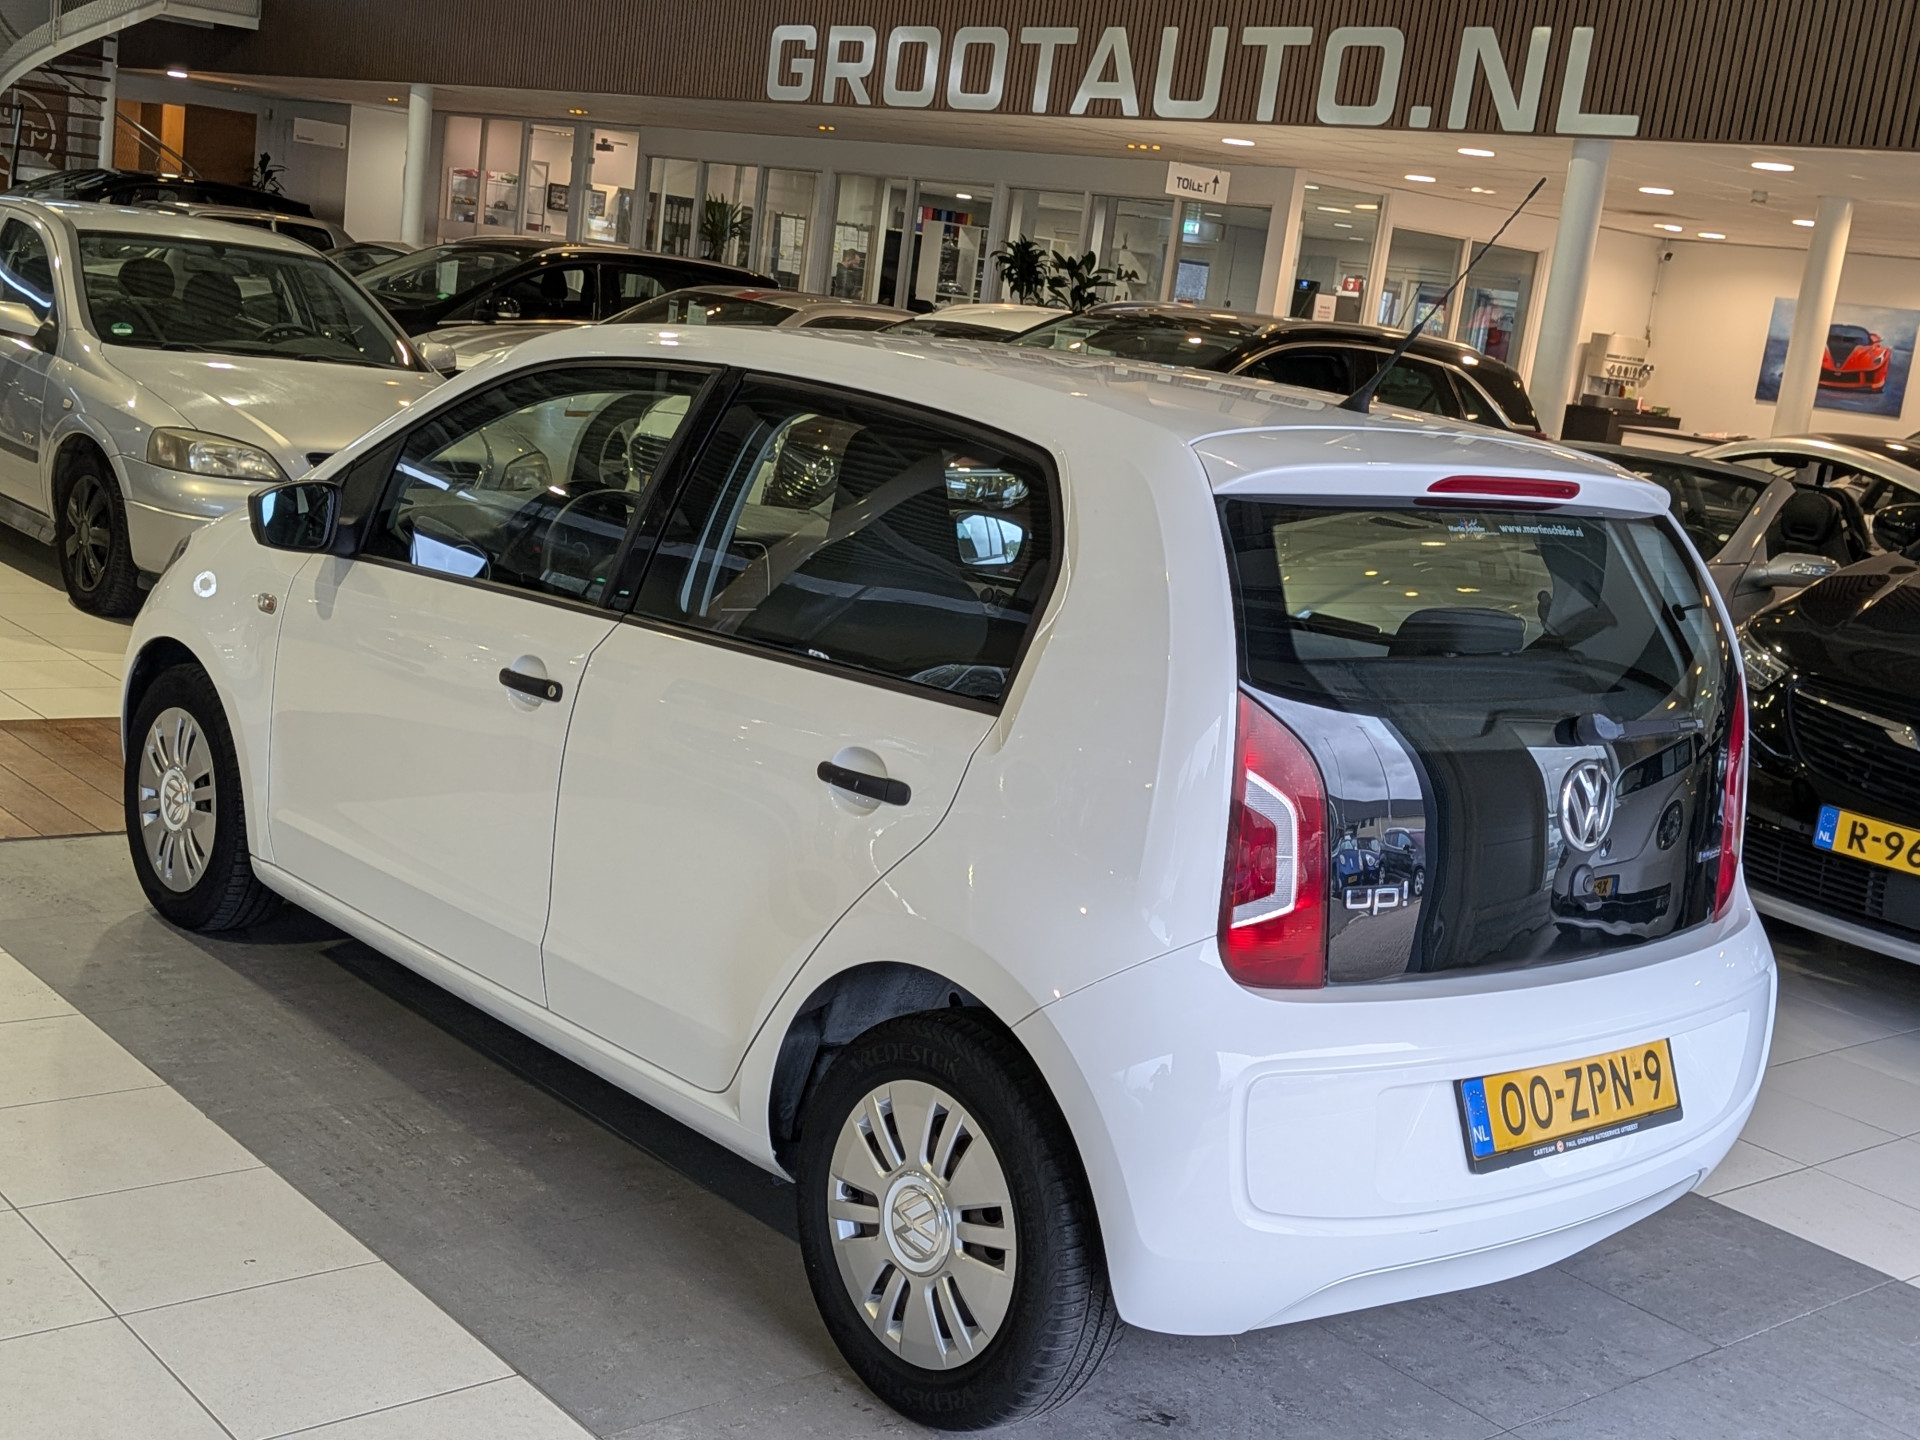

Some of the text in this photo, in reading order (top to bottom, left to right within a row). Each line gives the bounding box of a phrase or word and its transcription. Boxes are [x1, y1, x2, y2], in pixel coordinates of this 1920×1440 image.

[767, 25, 1640, 136] GROOTAUTO.NL
[1176, 176, 1210, 194] TOILET
[1818, 830, 1832, 843] NL
[1847, 820, 1920, 869] R-96
[1346, 880, 1409, 916] up!
[1500, 1049, 1662, 1137] 00-ZPN-9
[1472, 1125, 1490, 1144] NL
[1533, 1145, 1556, 1156] CARTEAM
[1566, 1140, 1577, 1148] PAUL
